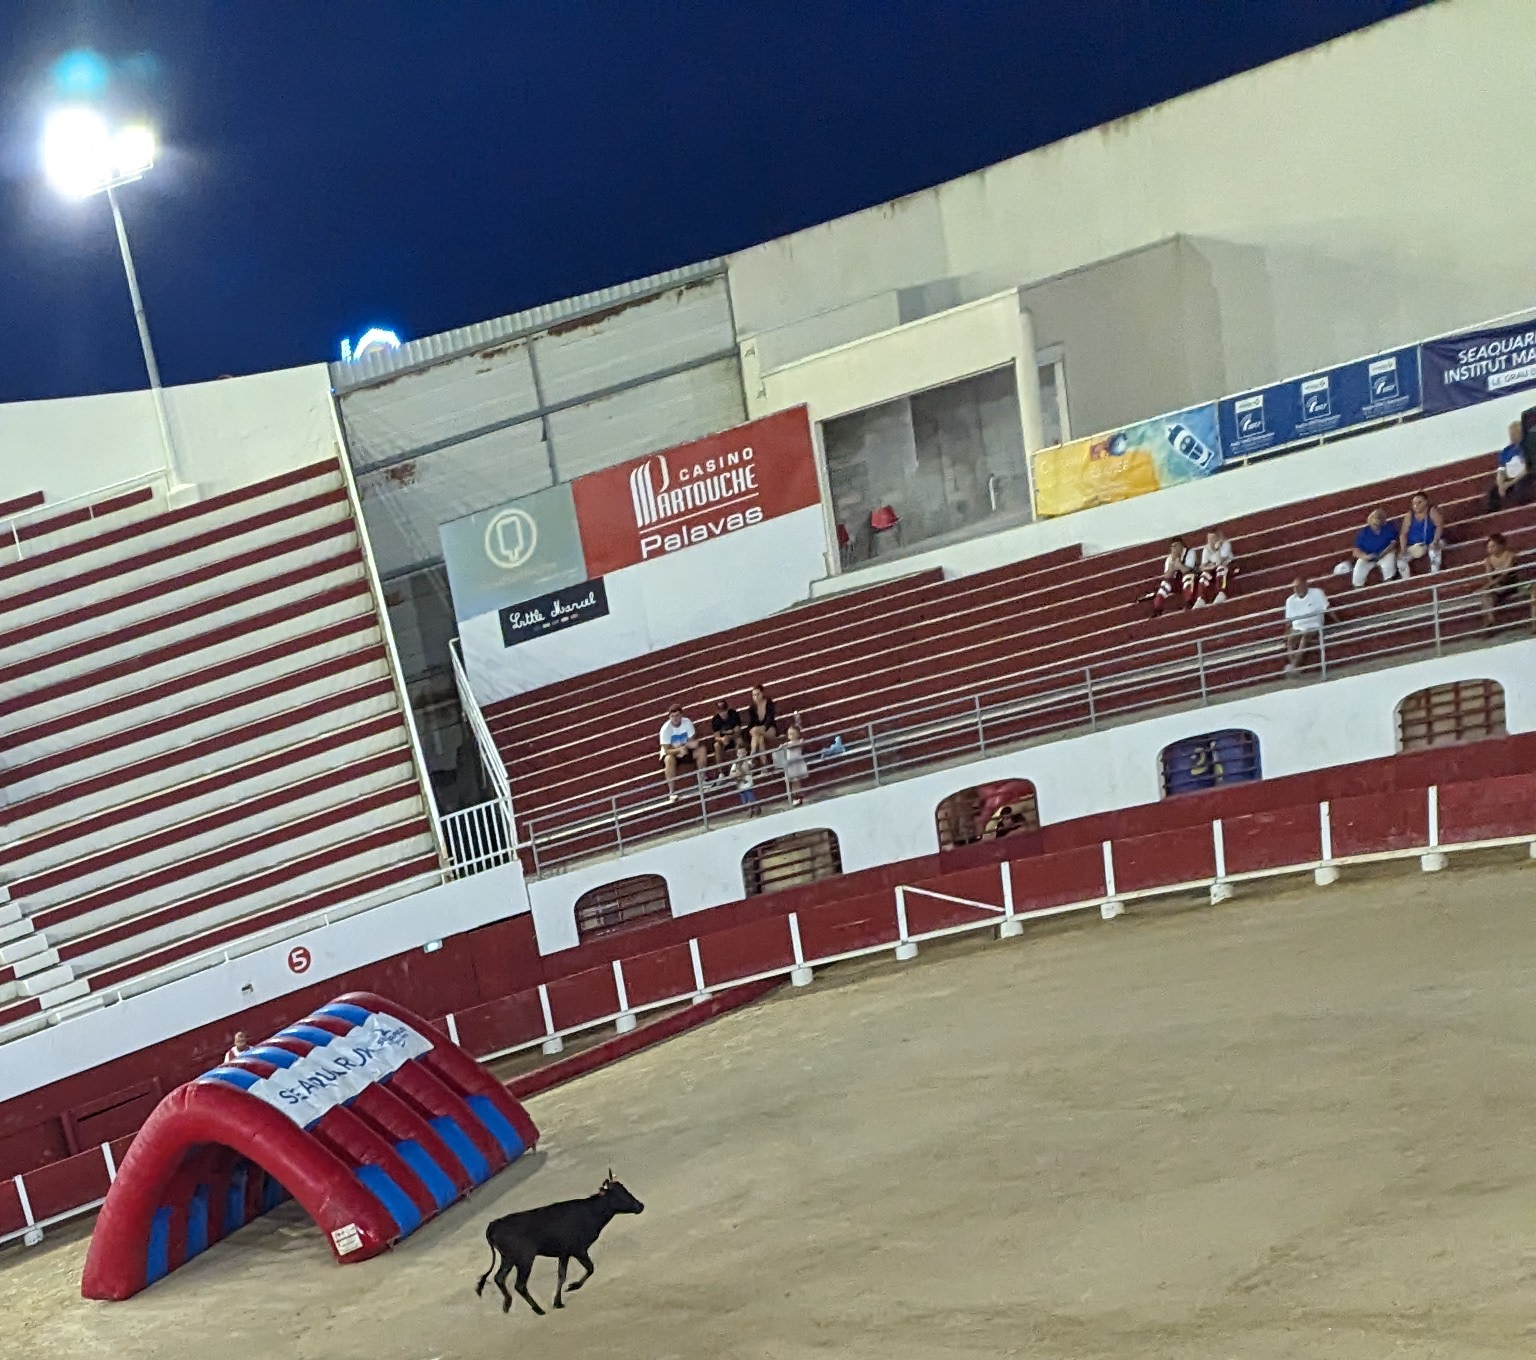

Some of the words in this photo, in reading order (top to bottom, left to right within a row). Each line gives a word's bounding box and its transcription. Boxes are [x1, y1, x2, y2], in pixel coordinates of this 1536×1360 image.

[1458, 332, 1536, 364] SEAQUAR
[1444, 355, 1508, 384] INSTITUT
[679, 447, 753, 481] CASINO
[640, 506, 764, 559] Palavas
[290, 948, 308, 971] 5
